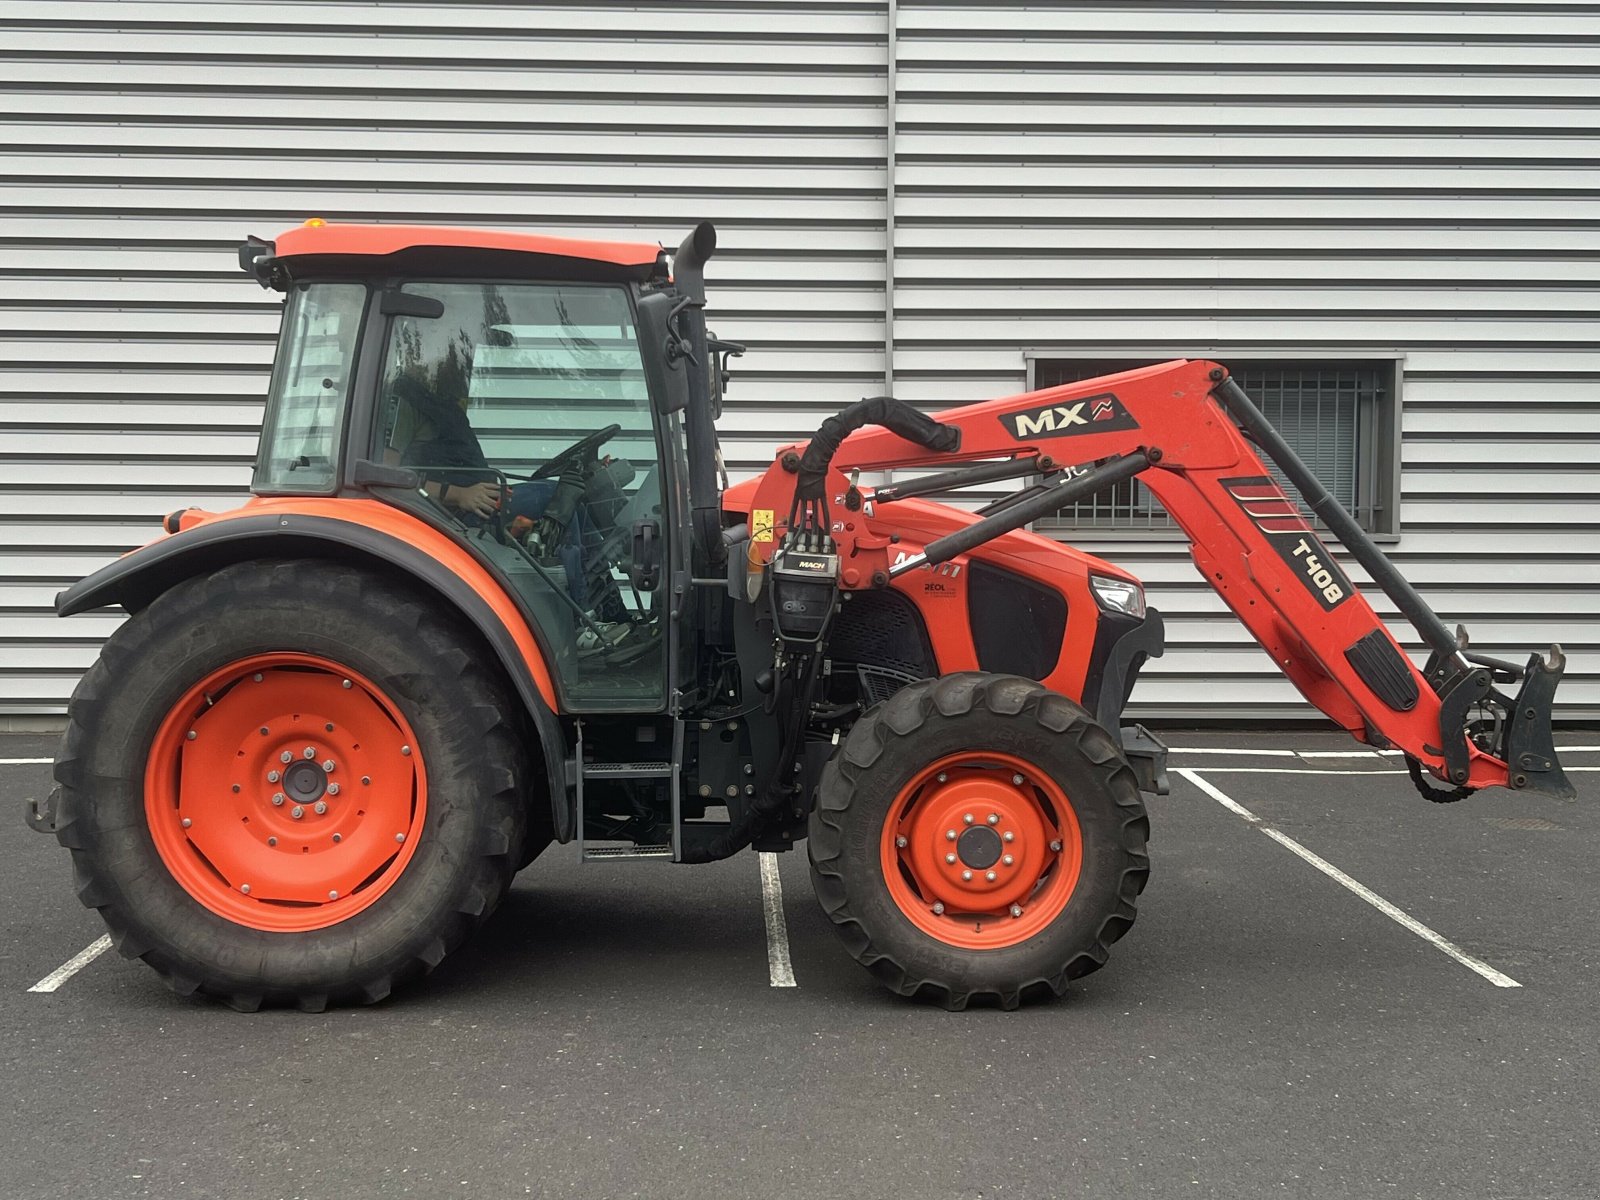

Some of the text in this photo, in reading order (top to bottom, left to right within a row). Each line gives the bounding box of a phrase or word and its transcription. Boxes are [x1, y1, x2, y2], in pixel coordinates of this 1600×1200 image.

[1015, 402, 1089, 437] MX
[799, 561, 825, 570] MACH
[1292, 538, 1344, 604] T408
